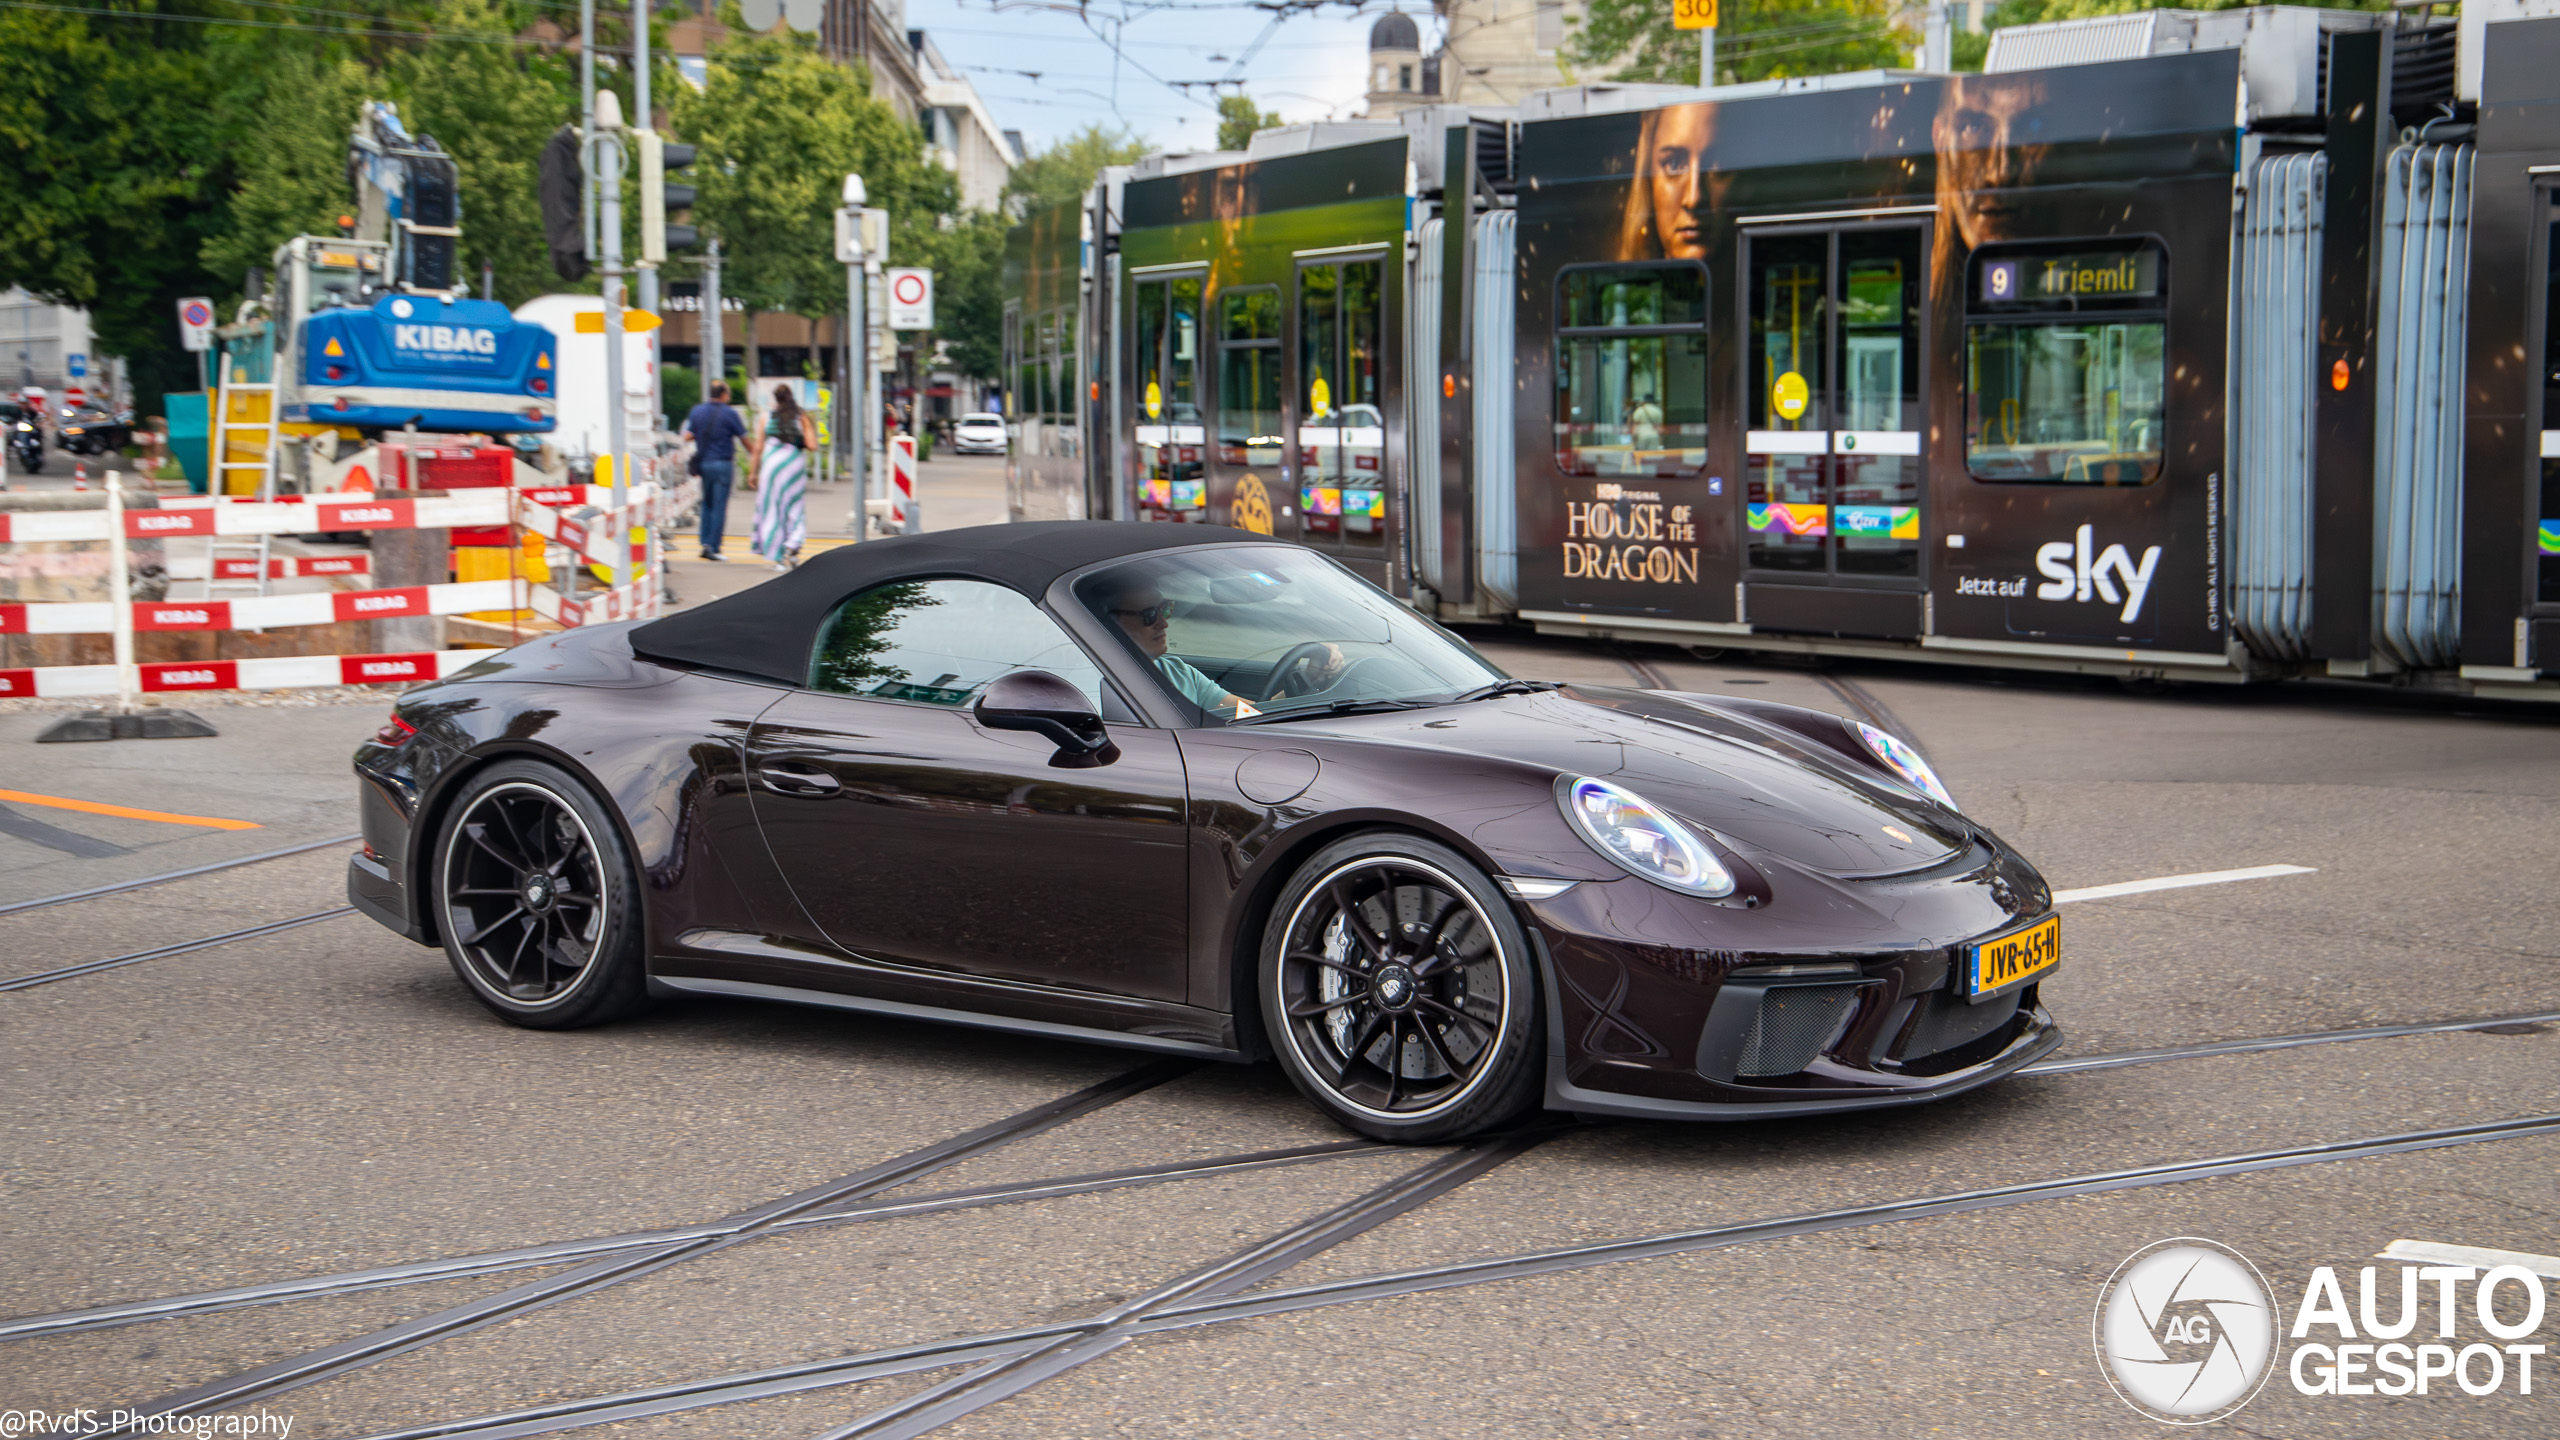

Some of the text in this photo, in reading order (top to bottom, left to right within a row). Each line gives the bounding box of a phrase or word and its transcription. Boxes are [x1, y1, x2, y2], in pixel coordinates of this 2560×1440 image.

[1679, 0, 1712, 18] 30
[1991, 257, 2136, 296] 9 Triemli
[394, 324, 497, 354] KIBAG
[137, 516, 193, 530] KIBAG
[339, 508, 394, 522] KIBAG
[1566, 502, 1664, 541] HOUSE
[1671, 505, 1691, 523] OF
[1667, 523, 1696, 542] THE
[1562, 542, 1700, 584] DRAGON
[2036, 524, 2162, 624] sky
[1955, 576, 2028, 597] Jetzt auf
[354, 595, 408, 612] KIBAG
[153, 609, 209, 624] KIBAG
[160, 669, 217, 685] KIBAG
[361, 661, 416, 676] KIBAG
[1985, 925, 2055, 984] JVR-65-H
